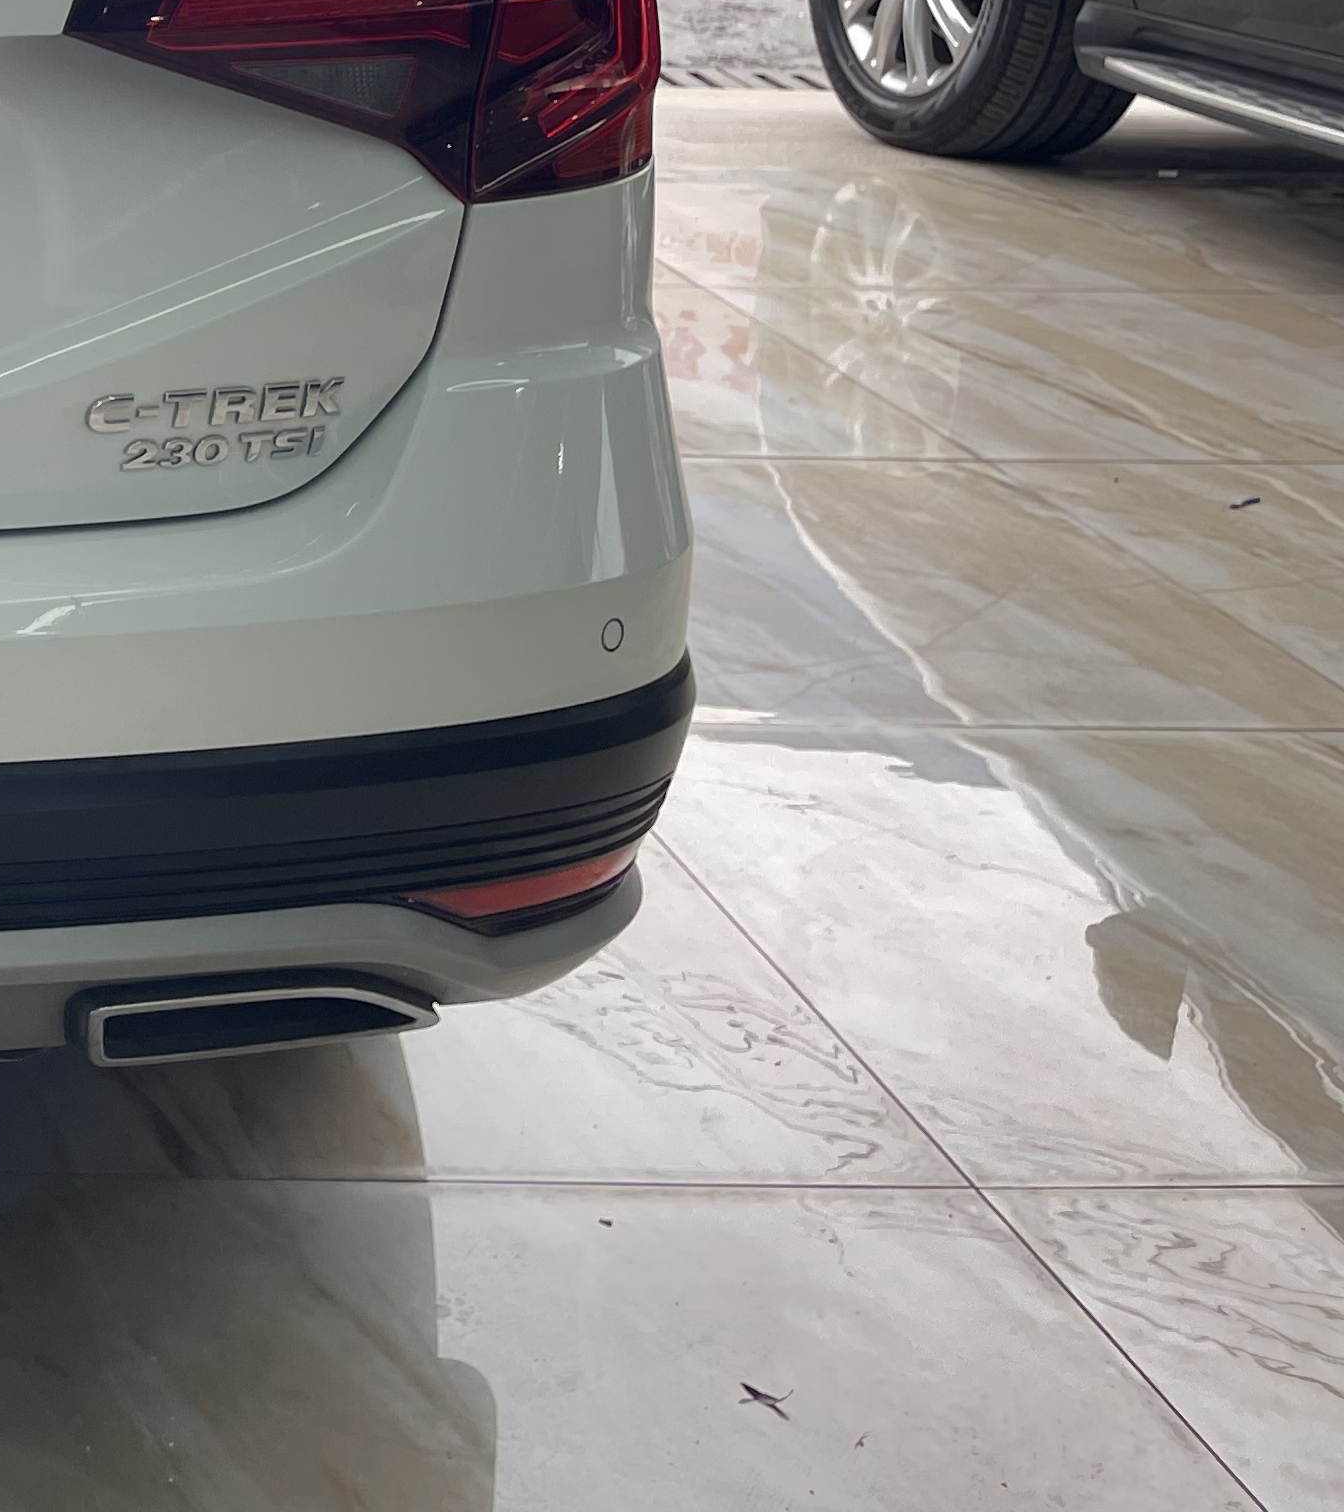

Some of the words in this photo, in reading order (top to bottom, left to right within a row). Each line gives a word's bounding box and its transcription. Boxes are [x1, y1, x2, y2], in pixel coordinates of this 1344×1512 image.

[85, 376, 346, 433] C-TREK
[120, 435, 229, 472] 230
[238, 425, 326, 463] TSI
